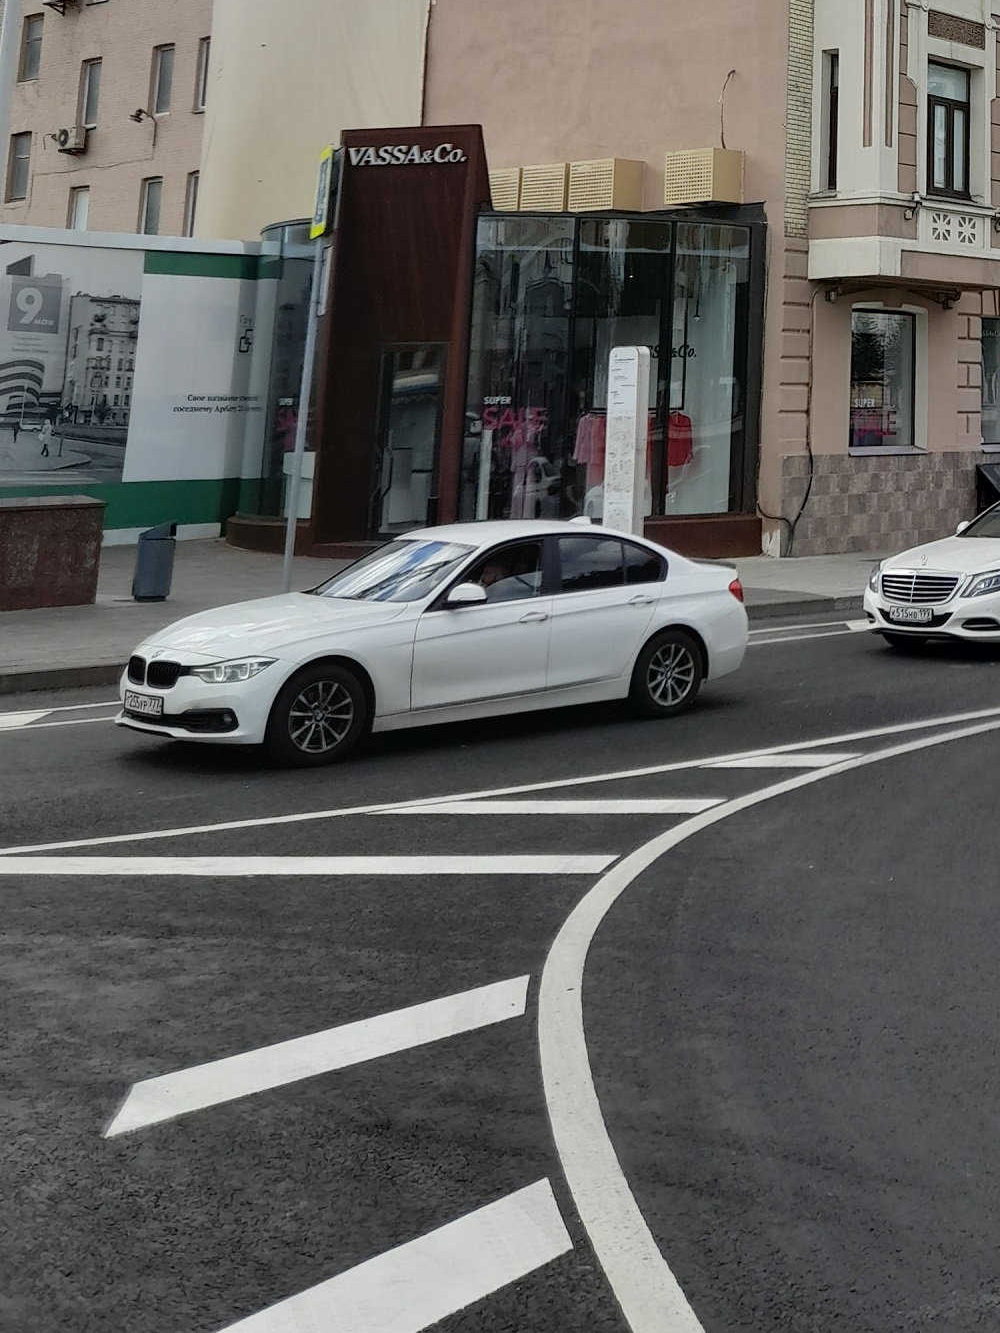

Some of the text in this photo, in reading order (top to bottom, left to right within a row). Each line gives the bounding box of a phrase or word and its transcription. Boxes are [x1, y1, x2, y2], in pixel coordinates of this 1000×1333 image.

[348, 143, 468, 166] VASSA&Co.
[16, 287, 43, 325] 9
[483, 396, 512, 405] SUPER
[854, 398, 876, 408] SUPER
